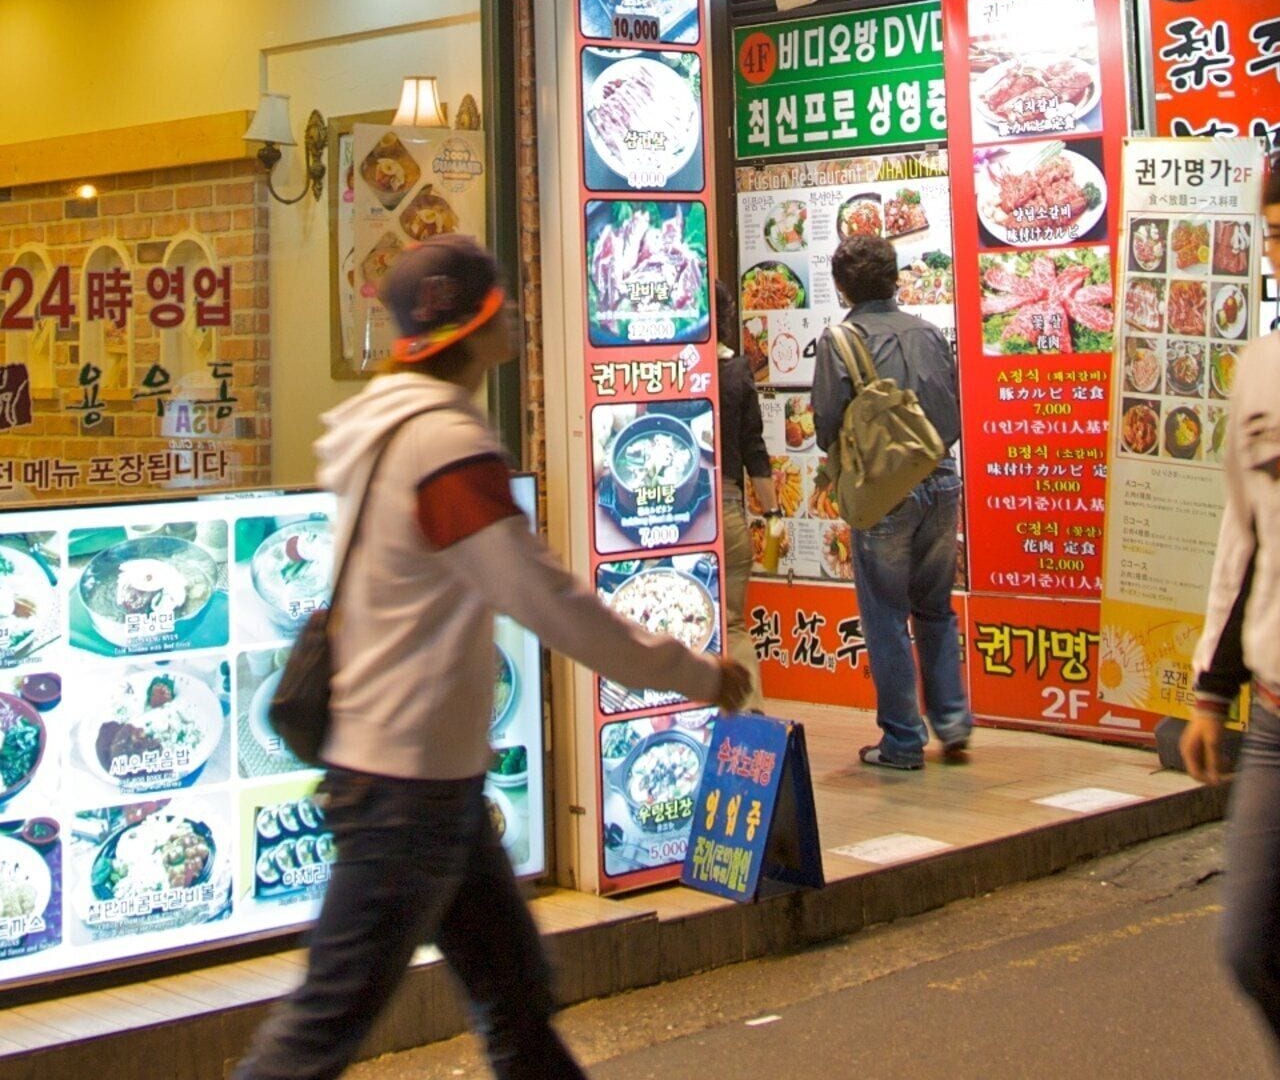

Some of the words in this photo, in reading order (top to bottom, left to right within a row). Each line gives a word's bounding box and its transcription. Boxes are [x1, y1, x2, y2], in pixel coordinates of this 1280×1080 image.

[613, 16, 659, 41] 10,000
[741, 42, 771, 78] 4F
[776, 20, 879, 71] 비디오방
[745, 85, 856, 148] 최신프로
[747, 171, 789, 190] Fusion
[791, 166, 866, 187] Restaurant
[1135, 157, 1232, 187] 권가명가
[1232, 167, 1253, 184] 2F
[809, 189, 844, 208] 특선안주
[1148, 193, 1239, 208] 食べ放題コース料理
[146, 264, 233, 328] 영업
[590, 359, 689, 396] 권가명가
[689, 369, 711, 394] 2F
[997, 369, 1040, 383] A정식
[64, 360, 240, 428] 용우동
[999, 386, 1063, 401] 豚カルビ
[1071, 386, 1105, 400] 定食
[1033, 403, 1072, 416] 7,000
[1007, 444, 1049, 460] B정식
[23, 458, 81, 488] 메뉴
[87, 451, 230, 487] 포장됩니다
[634, 484, 675, 506] 갈비탕
[1034, 479, 1081, 494] 15,000
[639, 524, 679, 546] 7,000
[1015, 521, 1059, 537] C정식
[1063, 540, 1096, 556] 定食
[1039, 557, 1085, 572] 12,000
[1041, 686, 1092, 720] 2F
[637, 799, 694, 824] 우렁된장
[649, 838, 688, 862] 5,000
